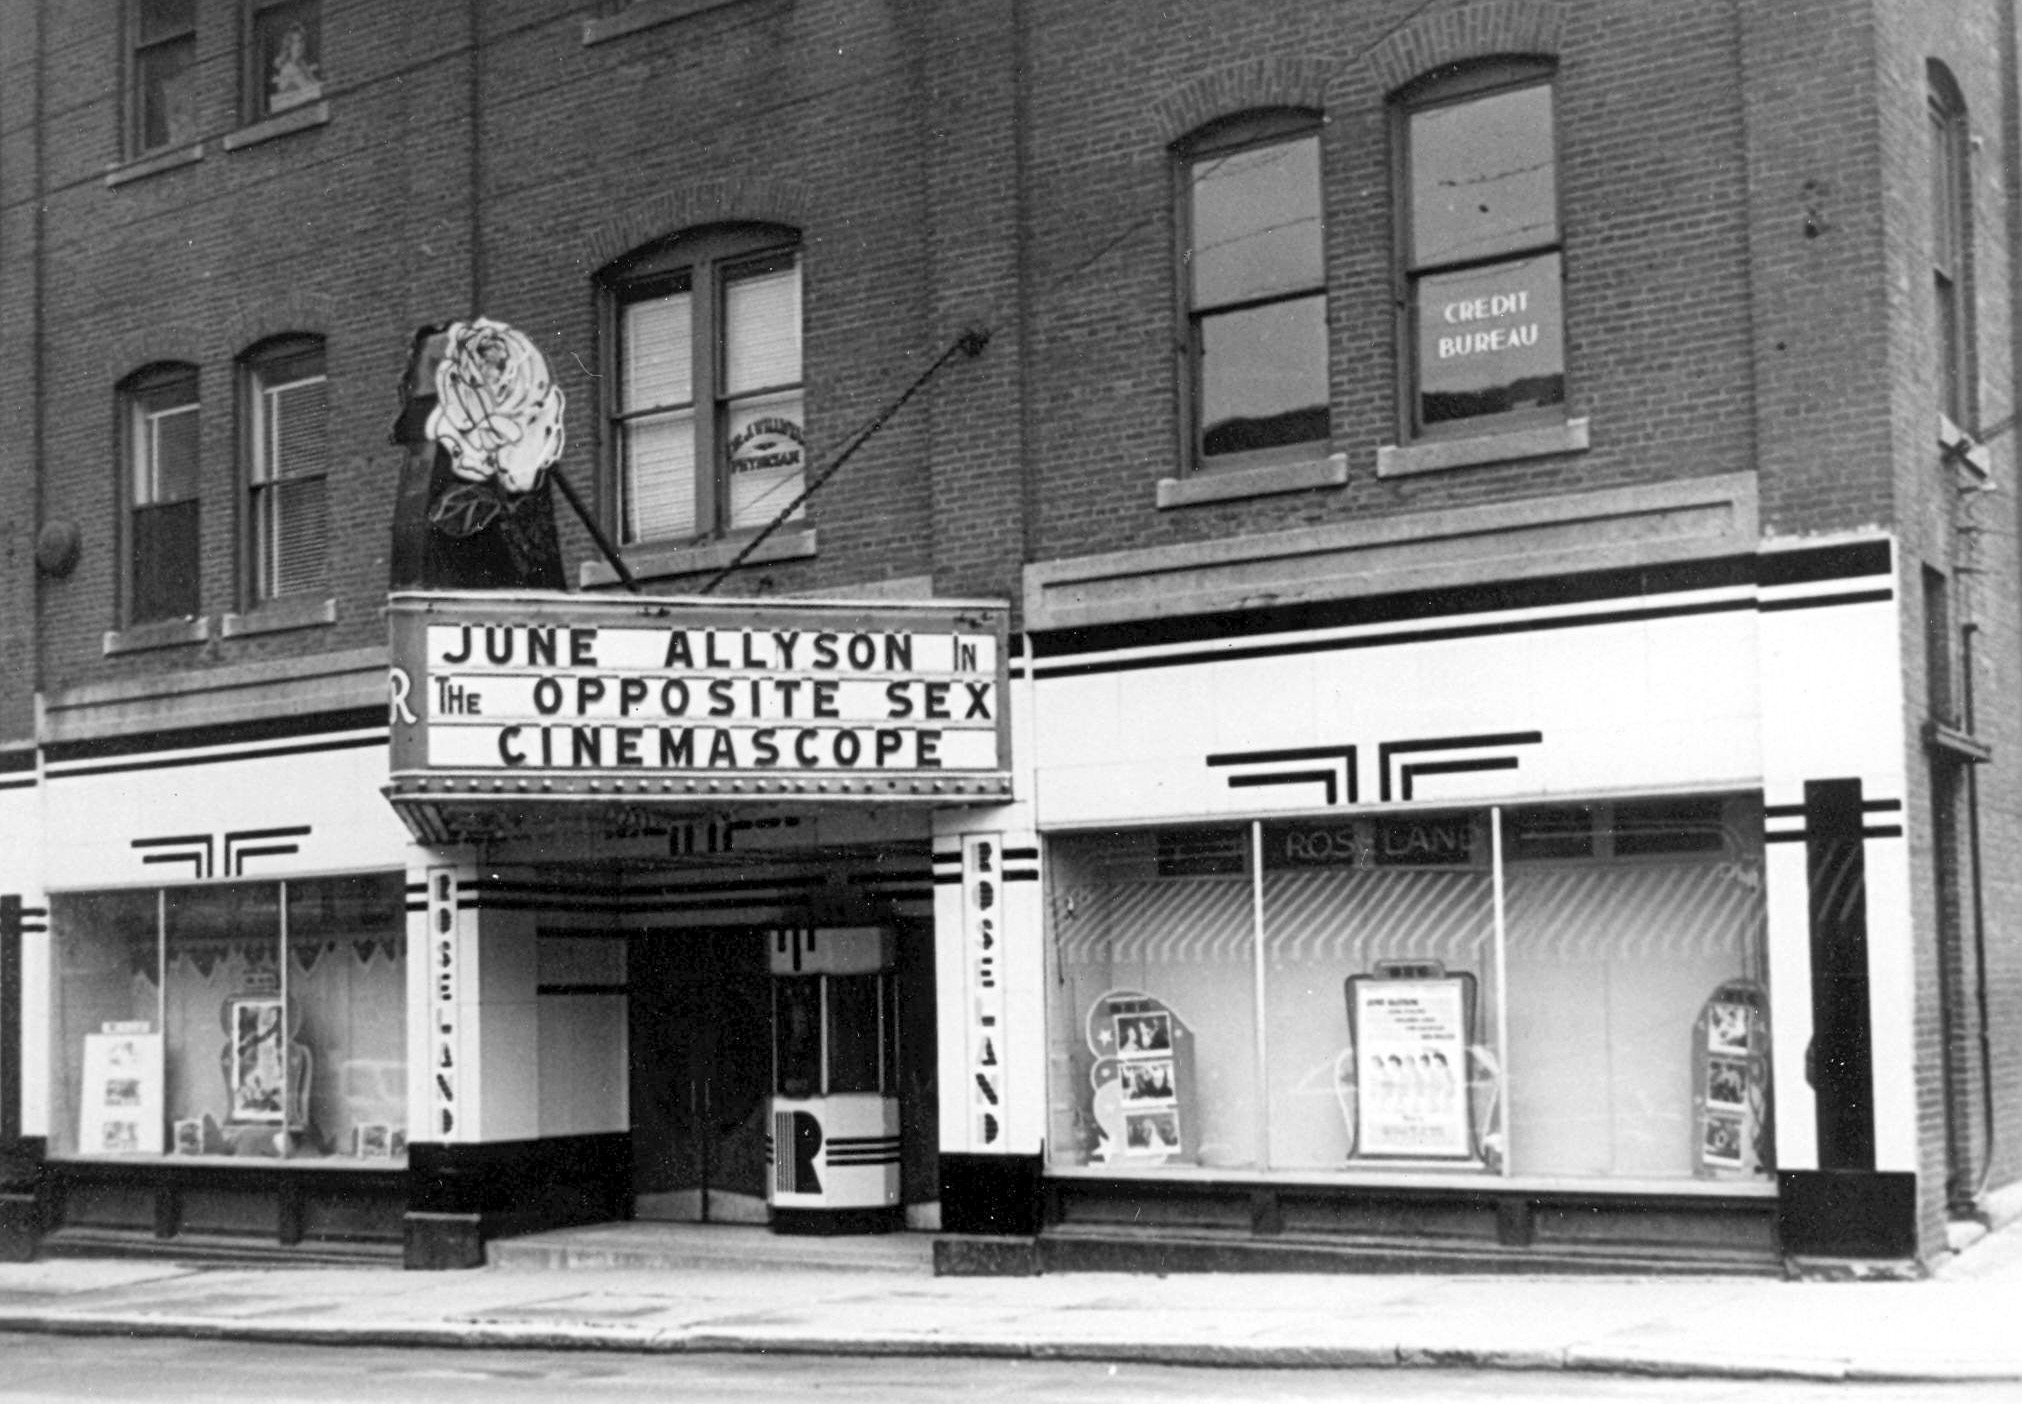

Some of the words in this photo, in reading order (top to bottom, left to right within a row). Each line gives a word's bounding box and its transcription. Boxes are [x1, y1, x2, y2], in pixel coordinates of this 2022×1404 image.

[1444, 290, 1528, 323] CREDIT
[1439, 323, 1538, 358] BUREAU
[442, 625, 599, 664] JUNE
[665, 630, 913, 669] ALLYSON
[953, 633, 977, 672] IN
[434, 675, 482, 716] THE
[533, 677, 840, 717] OPPOSITE
[887, 682, 992, 719] SEX
[498, 725, 943, 767] CINEMASCOPE
[435, 874, 453, 1135] ROSELAND
[971, 842, 998, 1145] ROSELAND
